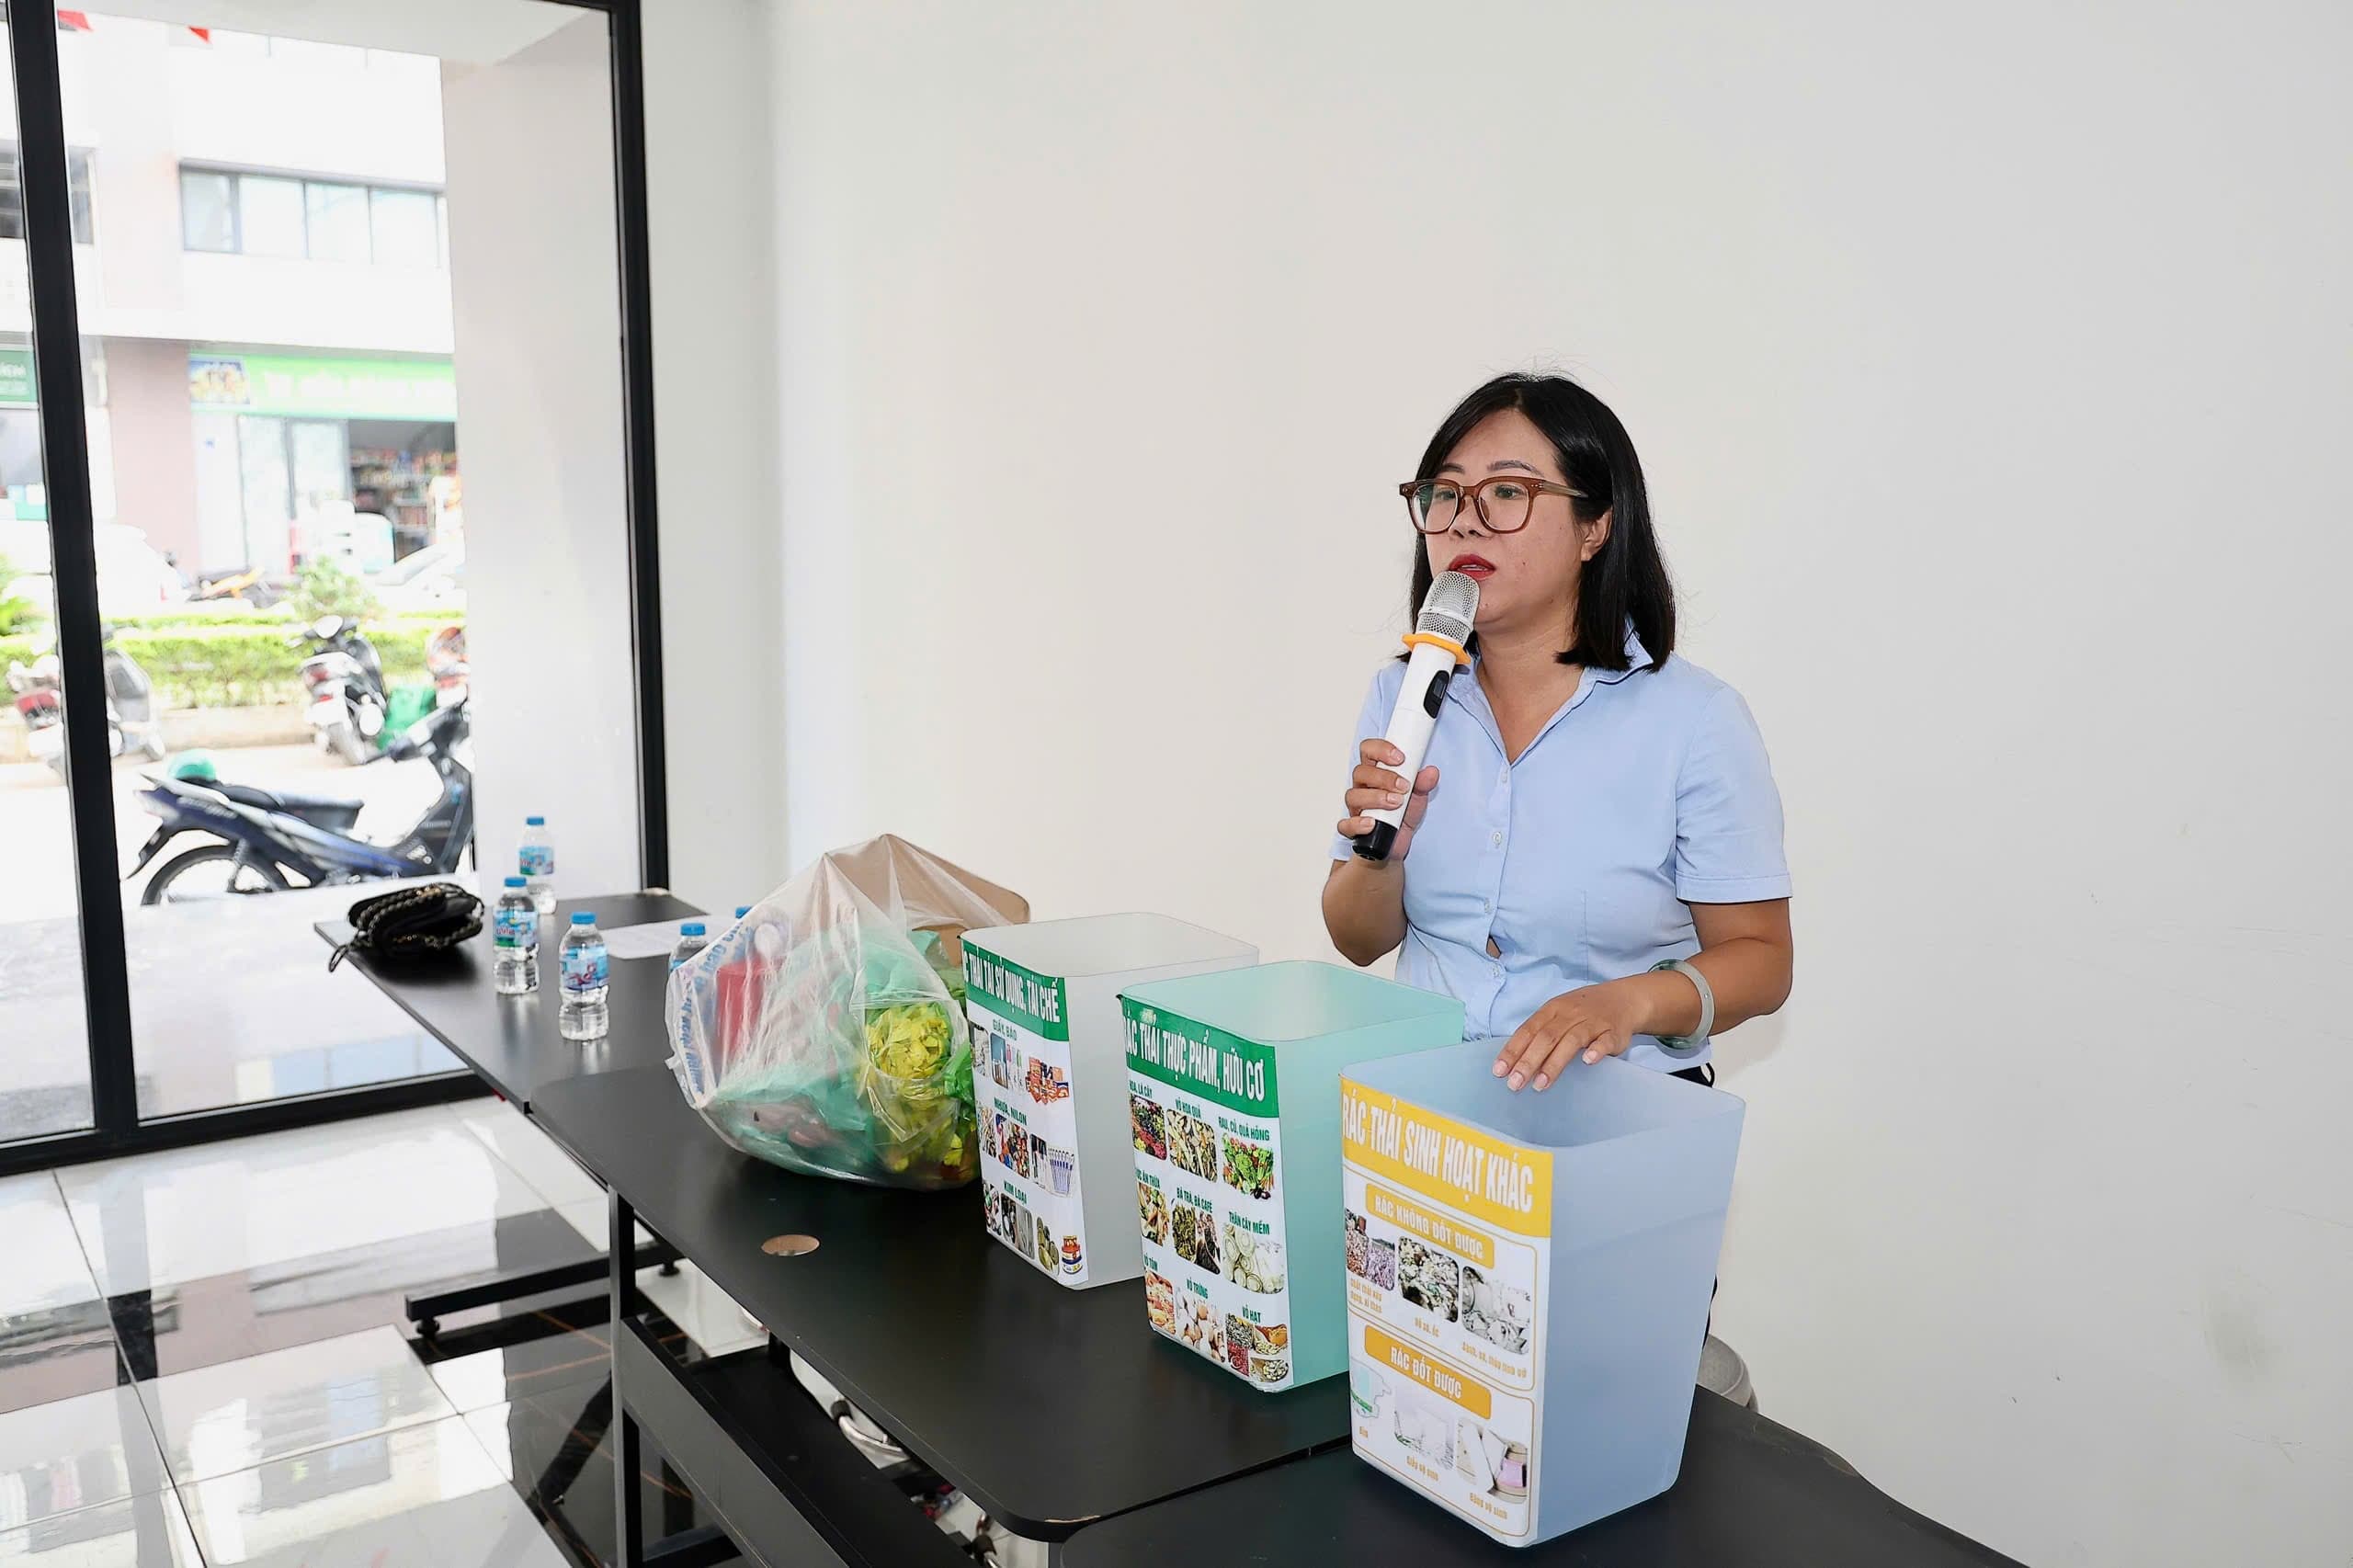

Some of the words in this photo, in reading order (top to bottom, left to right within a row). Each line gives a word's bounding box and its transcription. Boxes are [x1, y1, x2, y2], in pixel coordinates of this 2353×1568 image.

[1005, 970, 1027, 1015] DỤNG,
[1027, 974, 1039, 1017] TÁI
[1040, 977, 1060, 1023] CHẾ
[1140, 1014, 1160, 1065] THẢI
[1163, 1030, 1187, 1080] THỰC
[1189, 1028, 1221, 1093] PHẨM,
[1222, 1047, 1244, 1096] HỮU
[1245, 1059, 1265, 1102] CƠ
[1182, 1102, 1191, 1115] HOA
[1218, 1117, 1229, 1131] RAU,
[1230, 1119, 1238, 1134] CỦ,
[1239, 1122, 1249, 1138] QUẢ
[1342, 1088, 1366, 1145] RÁC
[1370, 1096, 1403, 1162] THẢI
[1404, 1120, 1442, 1177] SINH
[1442, 1135, 1484, 1202] HOẠT
[1485, 1153, 1534, 1213] KHÁC
[1004, 1180, 1014, 1195] KIM
[1015, 1187, 1028, 1204] LOẠI
[1229, 1211, 1241, 1226] THÂN
[1242, 1216, 1251, 1231] CÂY
[1375, 1194, 1394, 1218] RÁC
[1396, 1204, 1429, 1235] KHÔNG
[1432, 1219, 1452, 1244] ĐỐT
[1455, 1229, 1483, 1259] ĐƯỢC
[1242, 1304, 1249, 1319] VỎ
[1249, 1310, 1261, 1324] HẠT
[1391, 1346, 1410, 1370] RÁC
[1413, 1356, 1432, 1382] ĐỐT
[1434, 1369, 1462, 1399] ĐƯỢC
